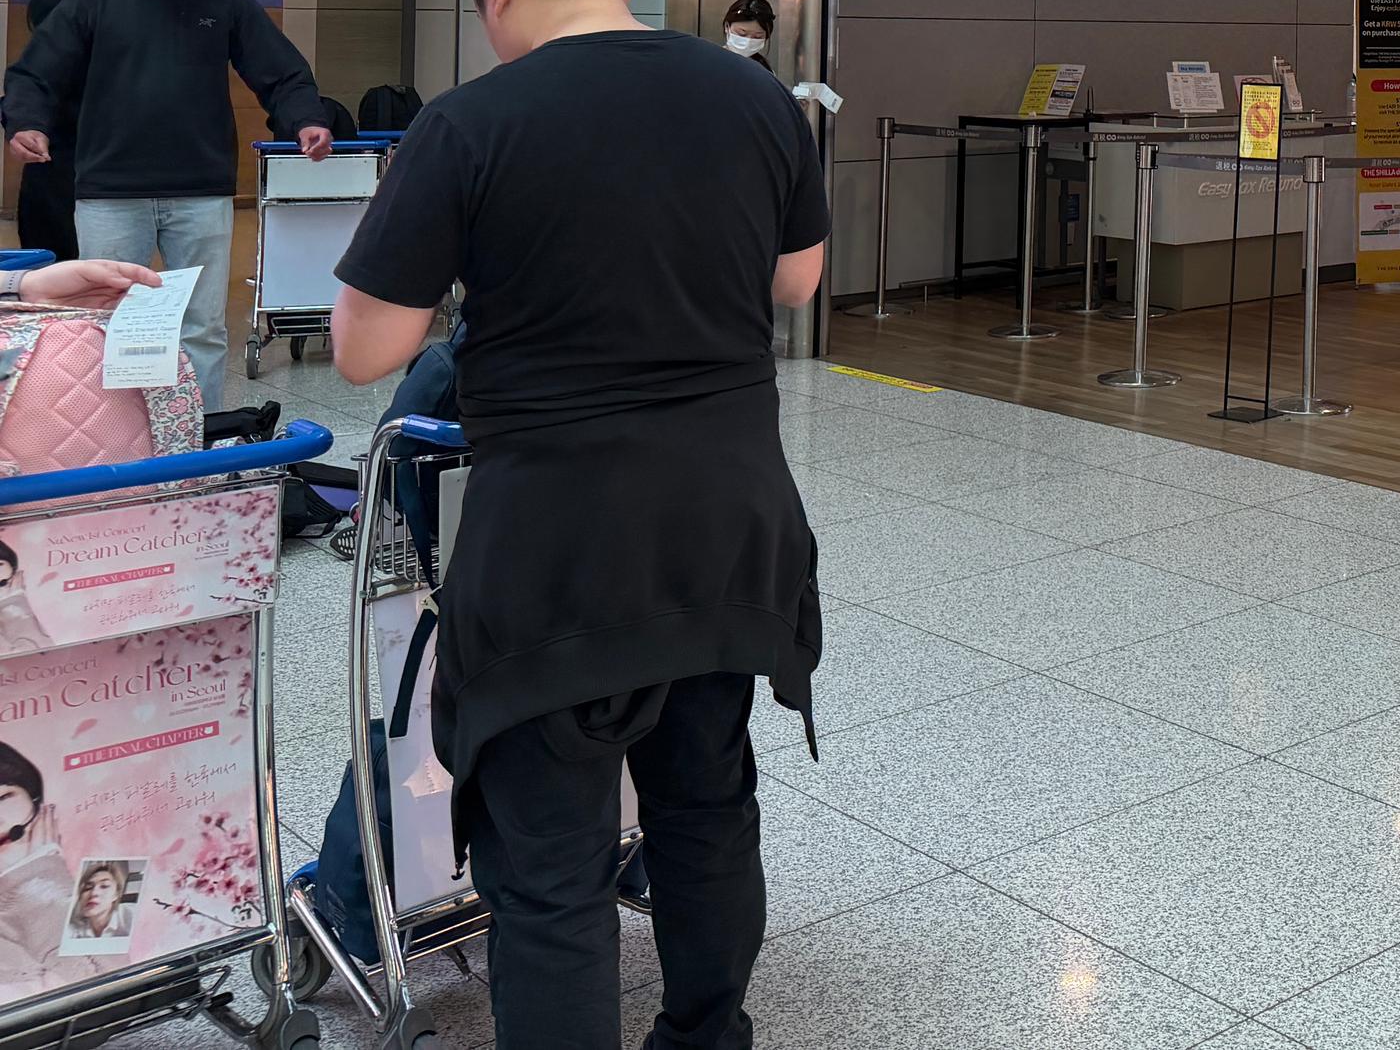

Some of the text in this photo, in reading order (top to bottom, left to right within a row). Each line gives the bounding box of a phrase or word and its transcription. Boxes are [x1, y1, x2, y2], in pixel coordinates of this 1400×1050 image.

[1371, 5, 1386, 13] Enjoy
[1364, 20, 1376, 28] Get
[1381, 20, 1397, 28] KRW
[1384, 82, 1400, 90] How
[1198, 181, 1232, 199] Easy
[103, 524, 148, 539] Concert
[47, 527, 207, 567] Dream Catcher
[205, 540, 230, 551] Seoul
[77, 576, 94, 588] THE
[120, 566, 164, 582] CHAPTER
[24, 656, 98, 681] Concert
[61, 662, 201, 708] Catcher
[171, 679, 226, 703] in Seoul
[81, 726, 205, 766] THE FINAL CHAPTER
[184, 762, 237, 788] 한국에서
